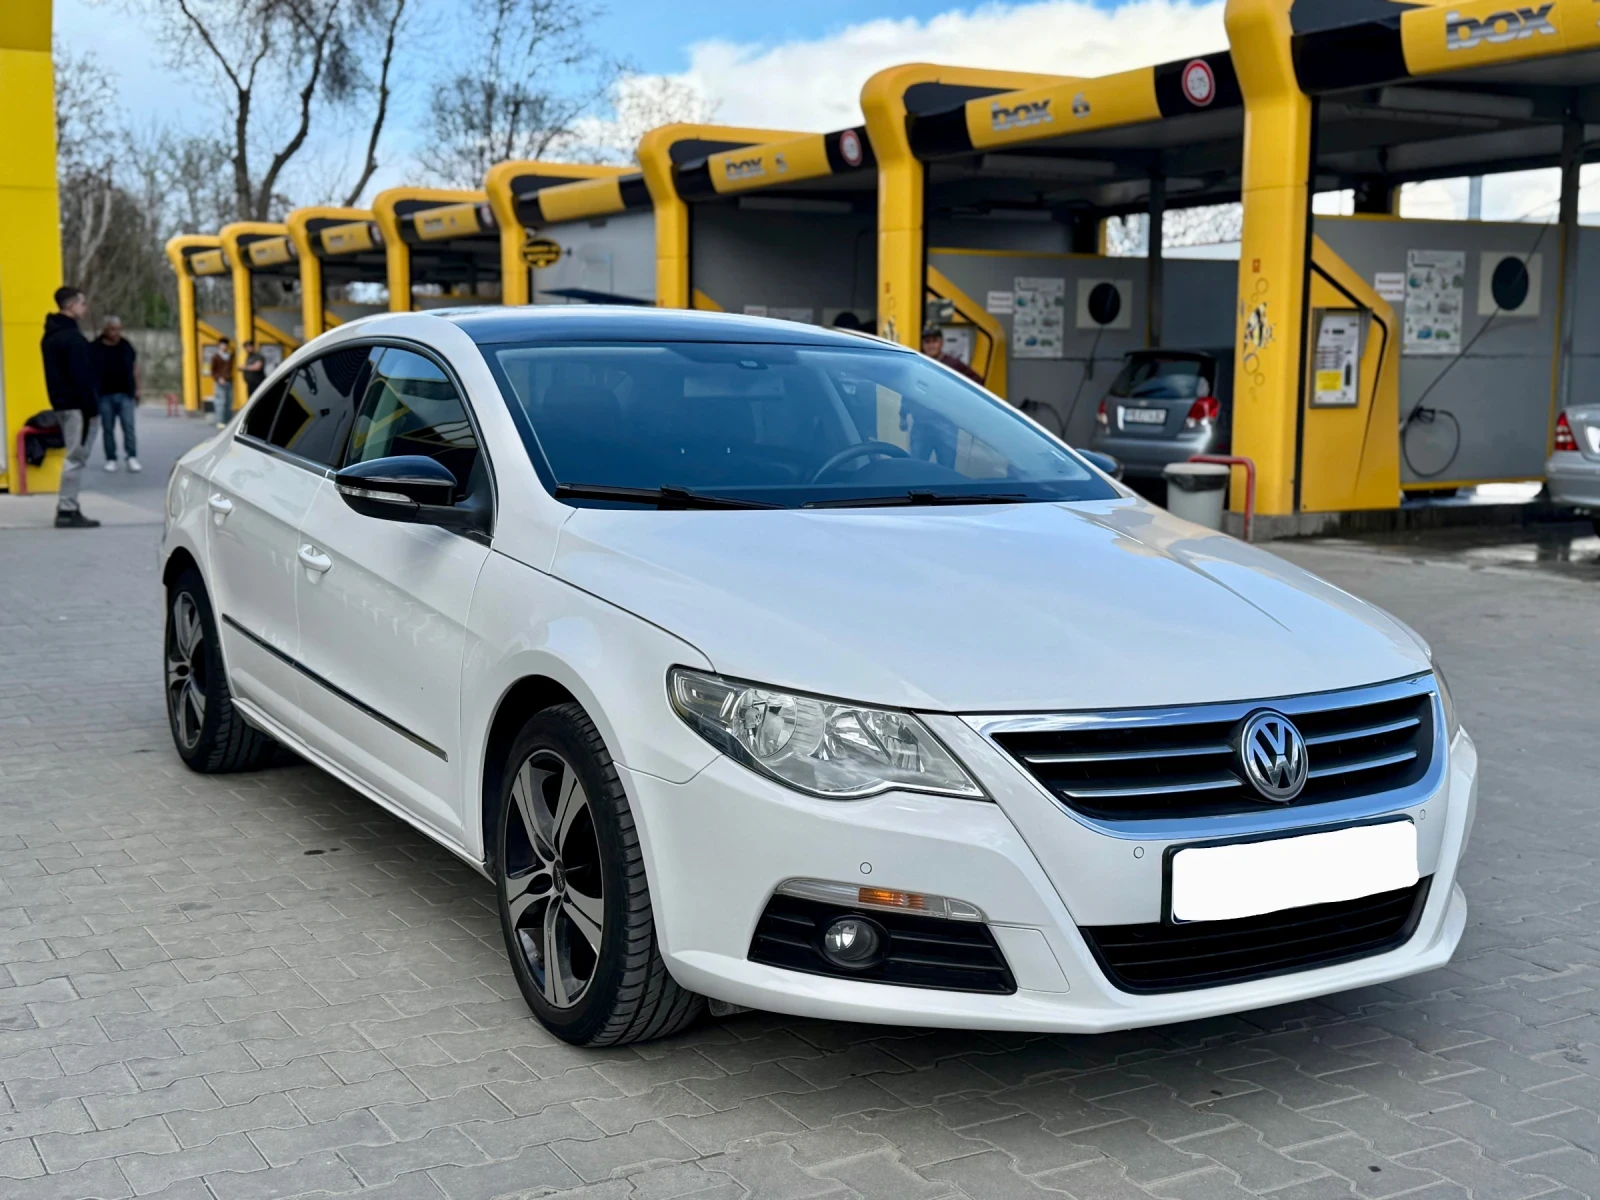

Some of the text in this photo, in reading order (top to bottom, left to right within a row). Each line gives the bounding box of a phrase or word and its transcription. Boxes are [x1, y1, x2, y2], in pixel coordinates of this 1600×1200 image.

[1446, 2, 1557, 51] box
[991, 92, 1091, 131] box 6
[725, 157, 766, 181] box
[1246, 715, 1304, 796] VW
